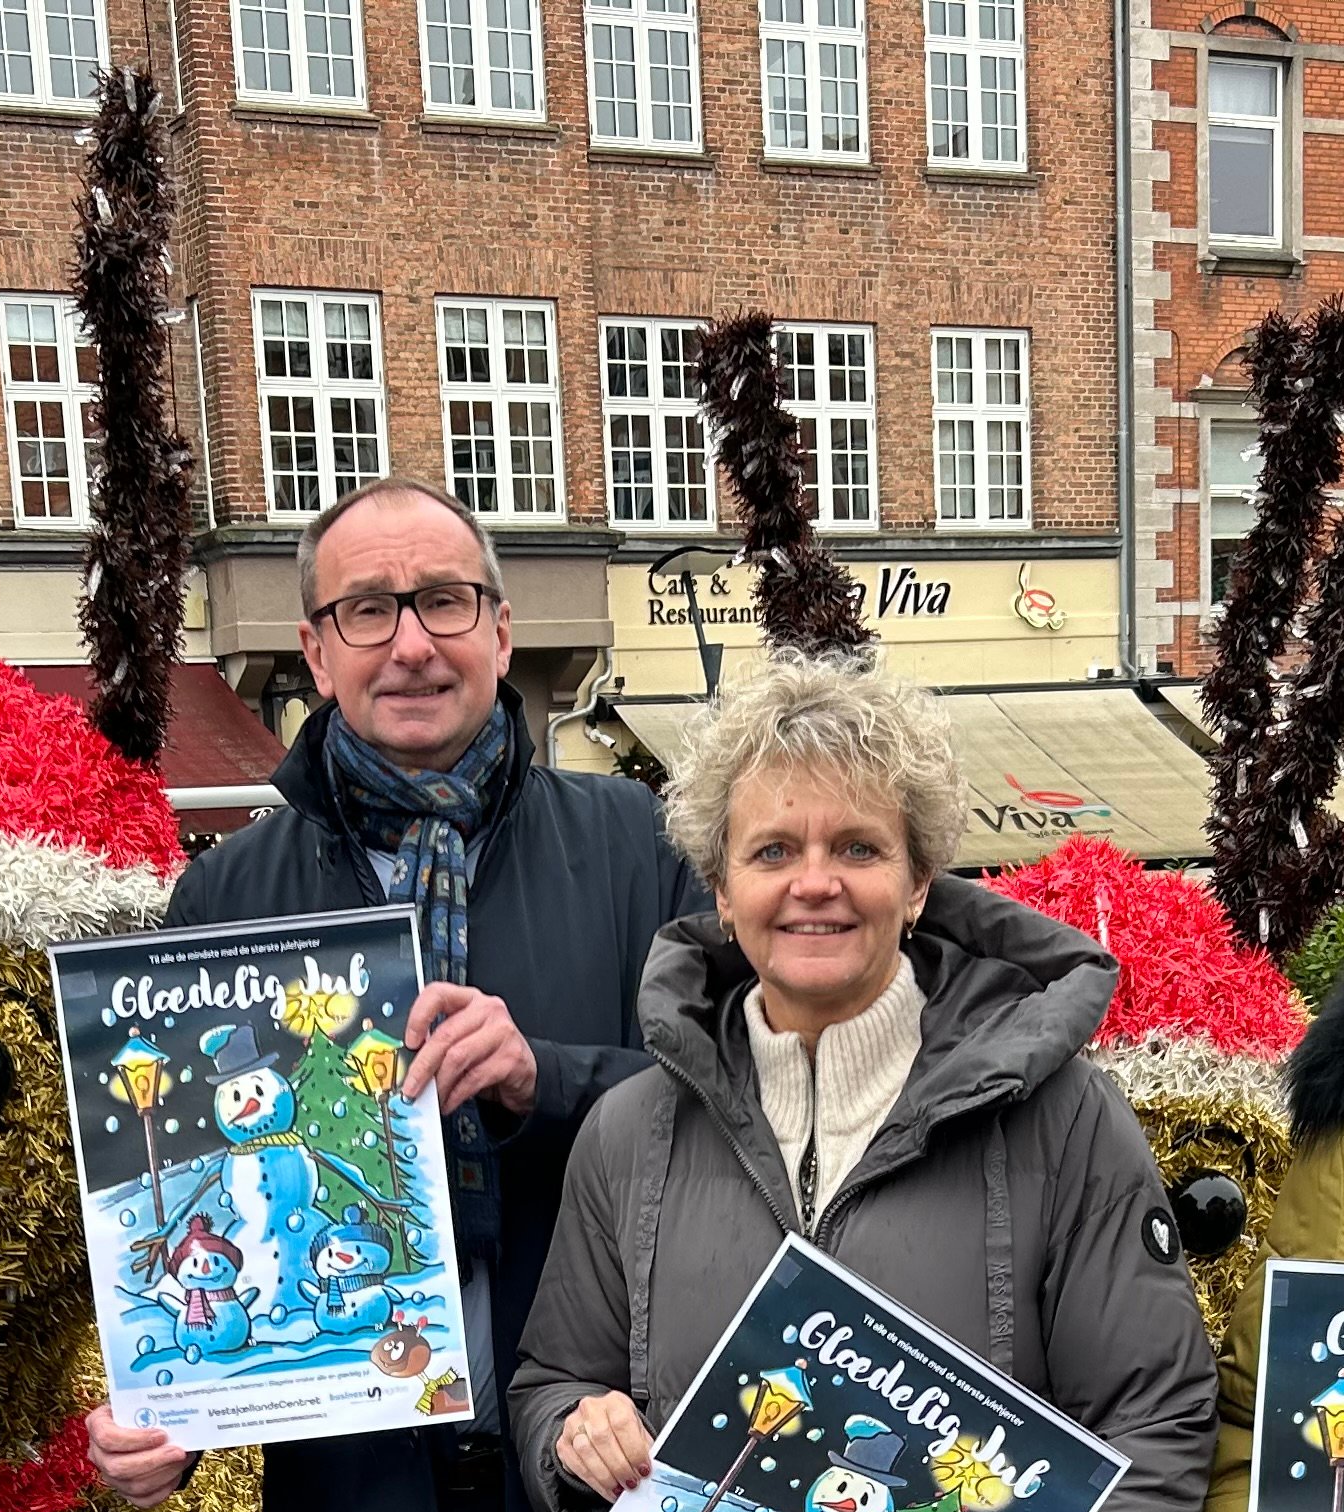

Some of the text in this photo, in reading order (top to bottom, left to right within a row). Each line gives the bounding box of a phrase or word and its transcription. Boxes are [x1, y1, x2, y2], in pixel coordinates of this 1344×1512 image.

[710, 573, 732, 595] &
[878, 567, 951, 618] Viva
[971, 804, 1077, 834] Viva
[111, 952, 369, 1020] Glædelig Jul
[990, 1263, 1009, 1344] MOS MOSH
[884, 1328, 900, 1344] de
[895, 1336, 931, 1365] mindste
[925, 1357, 948, 1377] med
[943, 1368, 959, 1385] de
[953, 1376, 987, 1403] største
[799, 1311, 1049, 1498] Glædelig Jul
